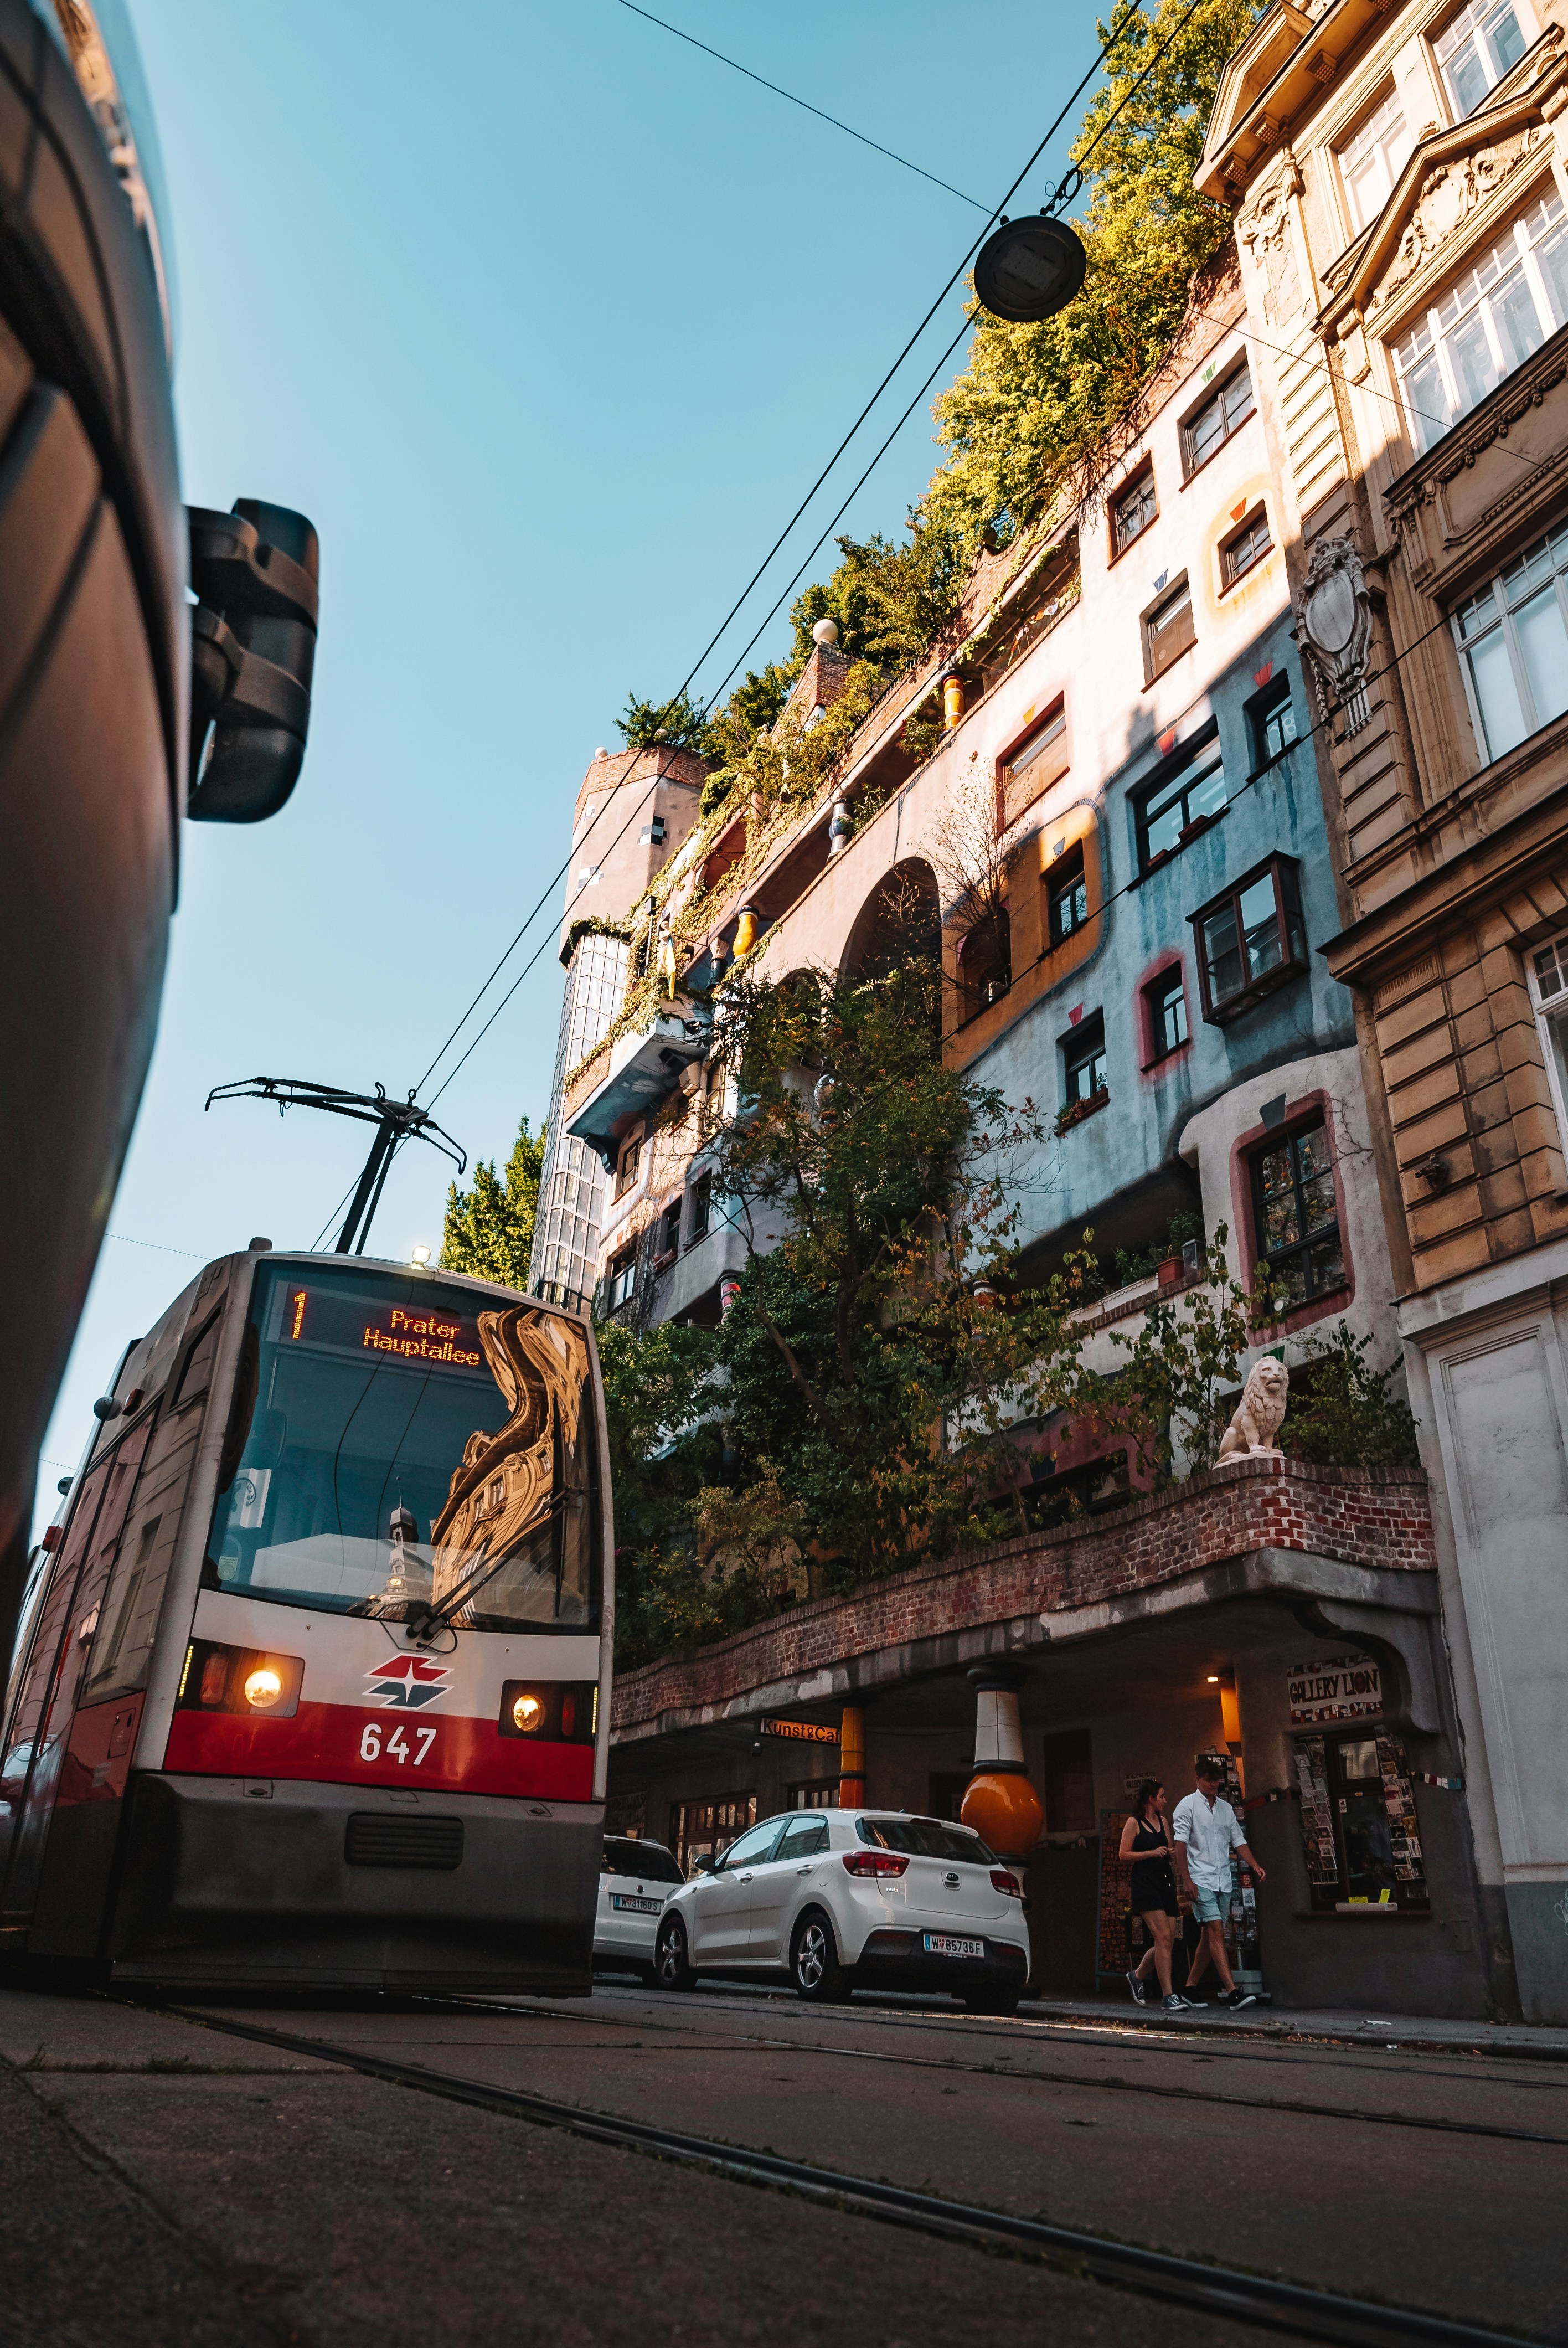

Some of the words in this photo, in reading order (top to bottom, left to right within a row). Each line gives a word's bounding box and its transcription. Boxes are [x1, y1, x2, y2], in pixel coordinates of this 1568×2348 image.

[292, 1291, 307, 1340] 1
[391, 1310, 460, 1340] Prater
[363, 1327, 480, 1366] Hauptallee
[1289, 1674, 1340, 1705] GALLERY
[1341, 1669, 1378, 1697] LION
[359, 1723, 437, 1766] 647
[763, 1719, 842, 1742] Kunst&Caf
[621, 1897, 627, 1907] W
[931, 1937, 939, 1950] W
